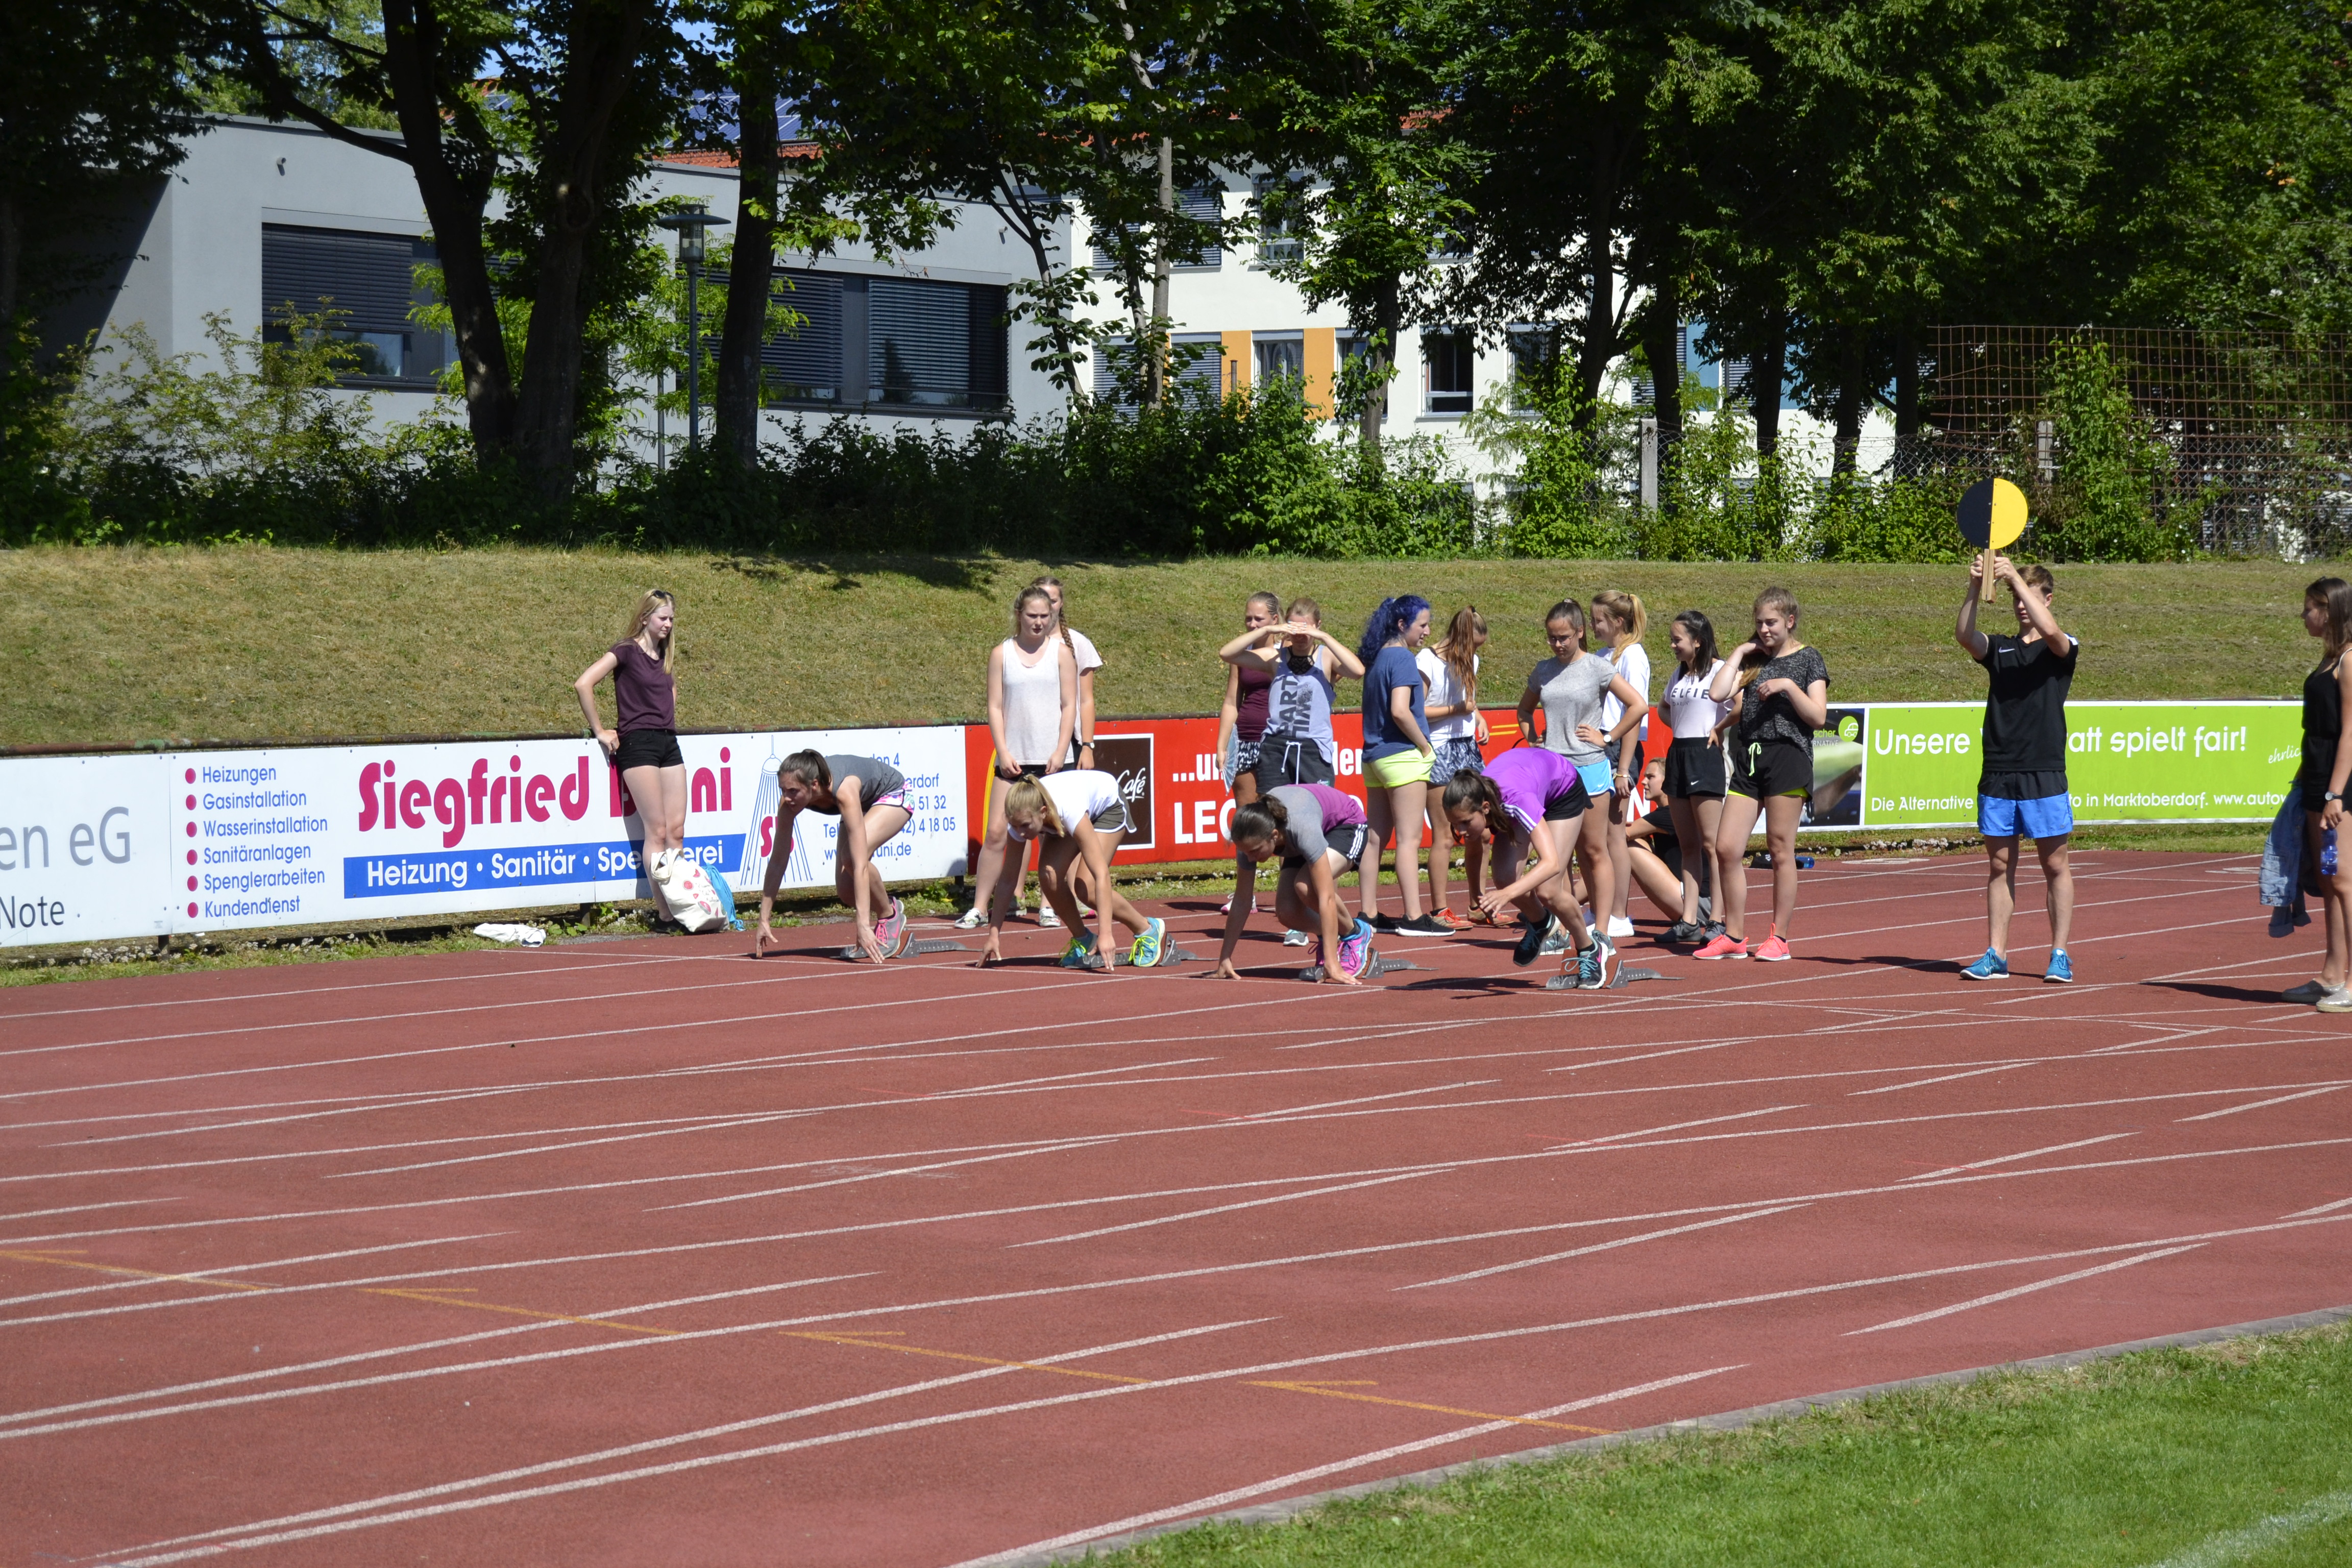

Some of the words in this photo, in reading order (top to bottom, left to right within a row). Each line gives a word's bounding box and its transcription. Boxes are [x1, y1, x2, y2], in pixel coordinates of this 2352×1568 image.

[1875, 729, 1970, 755] Unsere
[2111, 727, 2186, 757] spielt
[2194, 726, 2246, 757] fair!
[203, 767, 276, 786] Heizungen
[203, 791, 306, 810] Gasinstallation
[359, 755, 589, 848] Siegfried
[919, 796, 928, 810] 51
[934, 795, 946, 810] 32
[1872, 797, 1895, 811] Die
[1899, 796, 1974, 810] Alternative
[2087, 794, 2098, 806] in
[2104, 792, 2208, 808] Marktoberdorf.
[204, 816, 327, 837] Wasserinstallation
[919, 819, 925, 832] 4
[929, 818, 939, 831] 18
[943, 817, 955, 831] 05
[70, 807, 130, 866] eG
[204, 844, 310, 864] Sanitäranlagen
[368, 859, 468, 887] Heizung
[492, 849, 576, 877] Sanitär
[205, 868, 325, 893] Spenglerarbeiten
[0, 896, 64, 929] Note
[206, 896, 300, 917] Kundendienst
